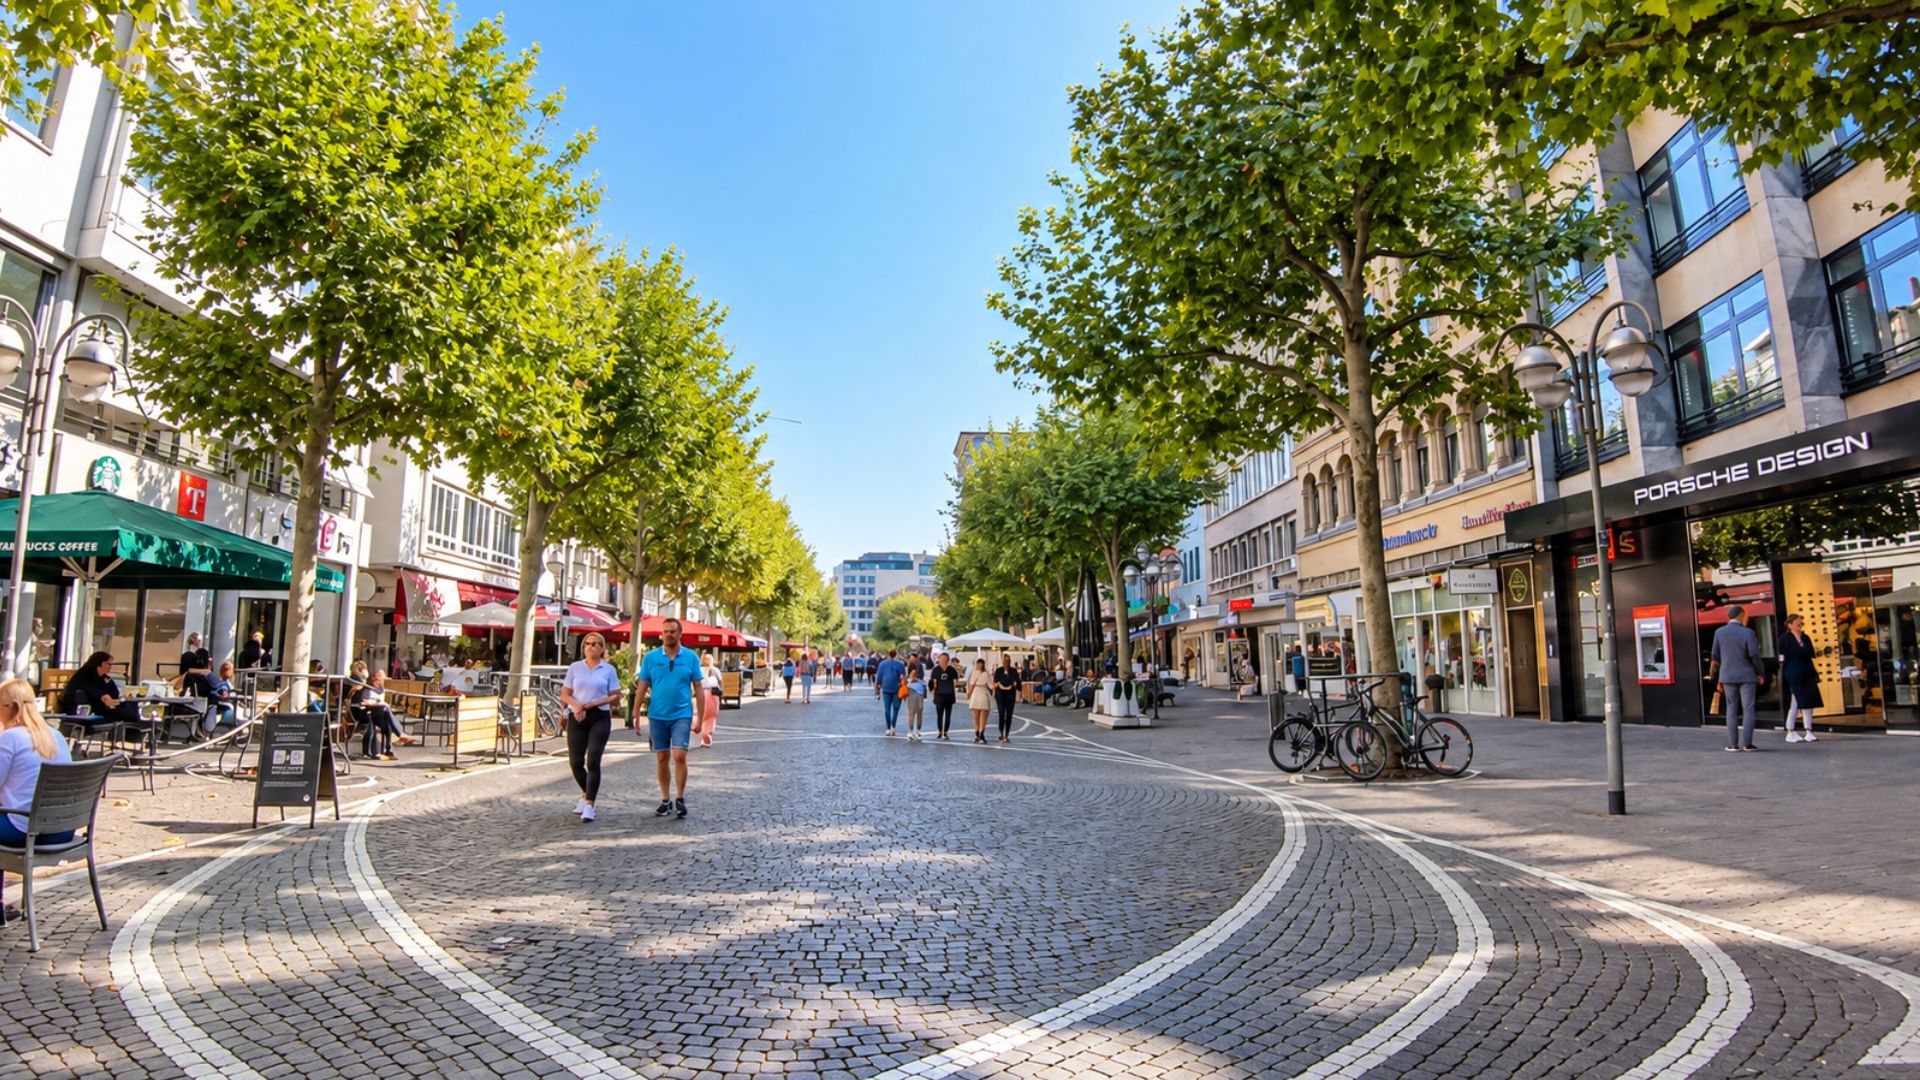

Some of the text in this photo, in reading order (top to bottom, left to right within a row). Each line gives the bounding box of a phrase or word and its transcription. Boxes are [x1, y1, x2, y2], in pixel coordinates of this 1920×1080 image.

[1633, 431, 1871, 505] PORSCHE DESIGN
[186, 486, 205, 515] T
